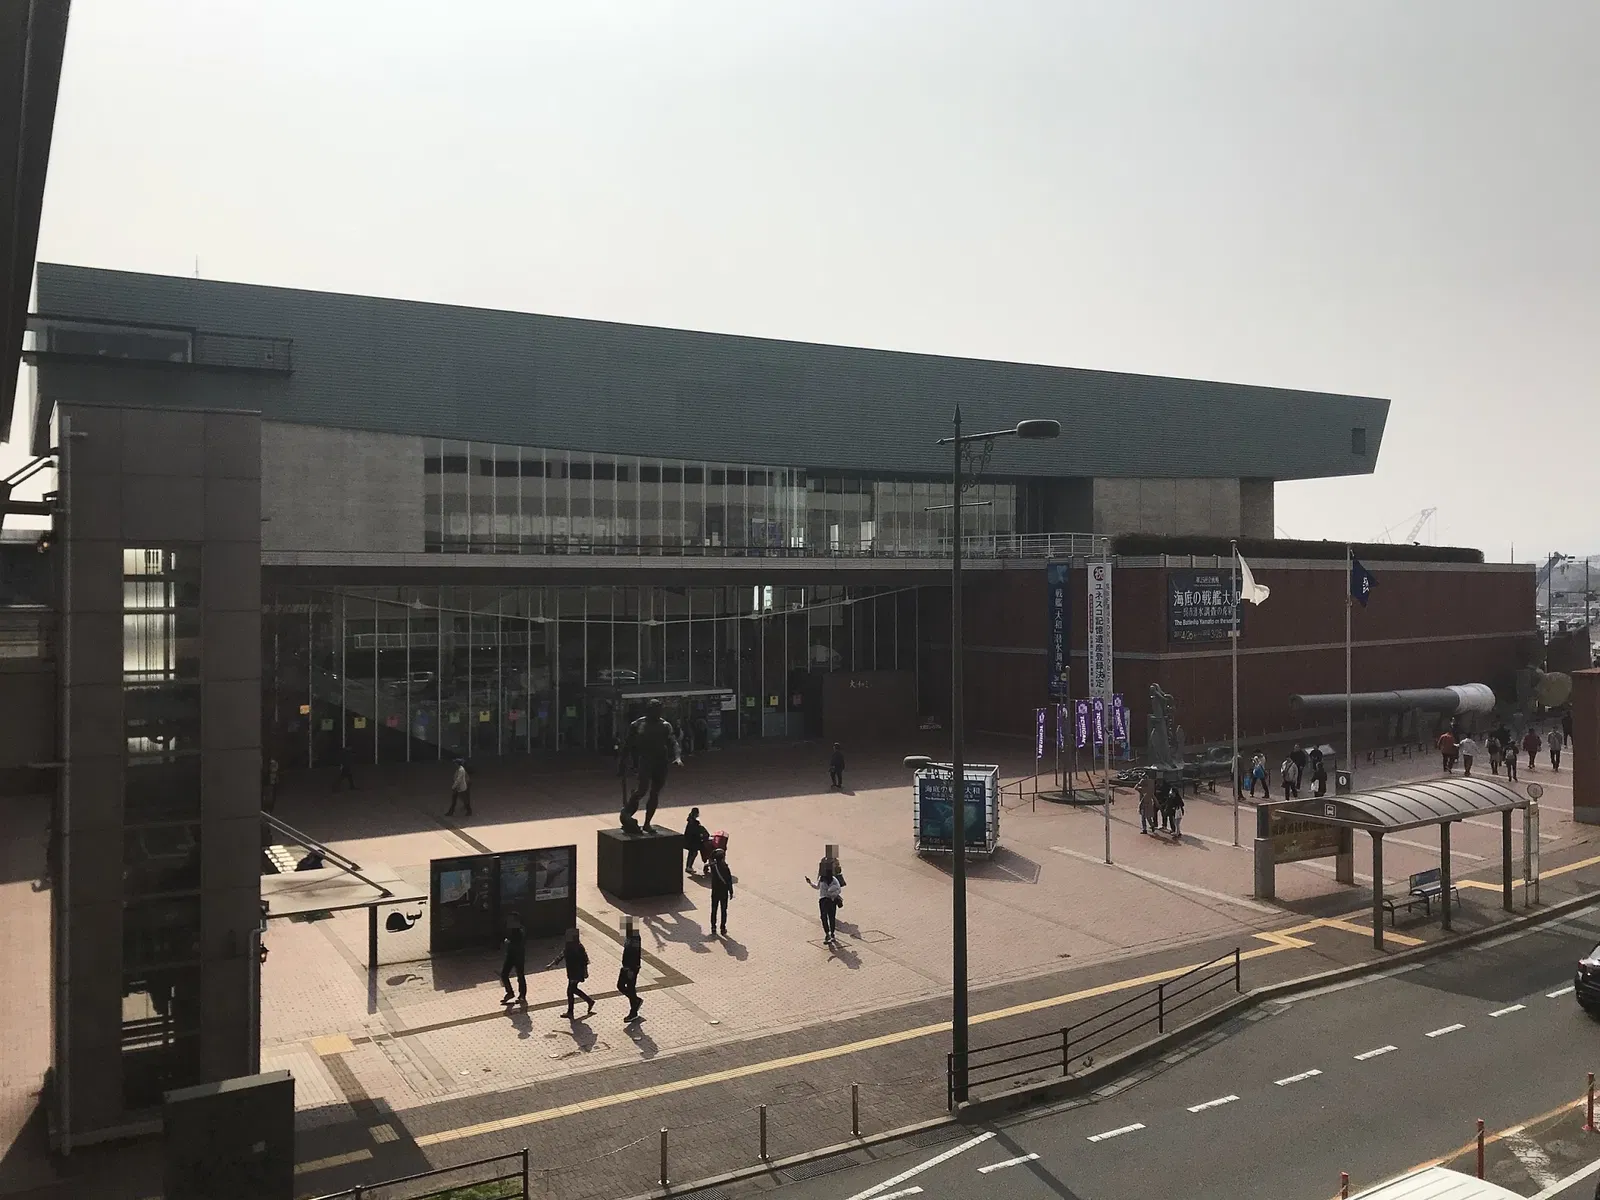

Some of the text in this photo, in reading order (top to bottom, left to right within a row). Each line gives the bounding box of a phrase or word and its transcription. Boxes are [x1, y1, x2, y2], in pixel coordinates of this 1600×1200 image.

[1094, 583, 1104, 688] ユネスコ記憶遺産登録決定
[1199, 617, 1214, 625] Yamato
